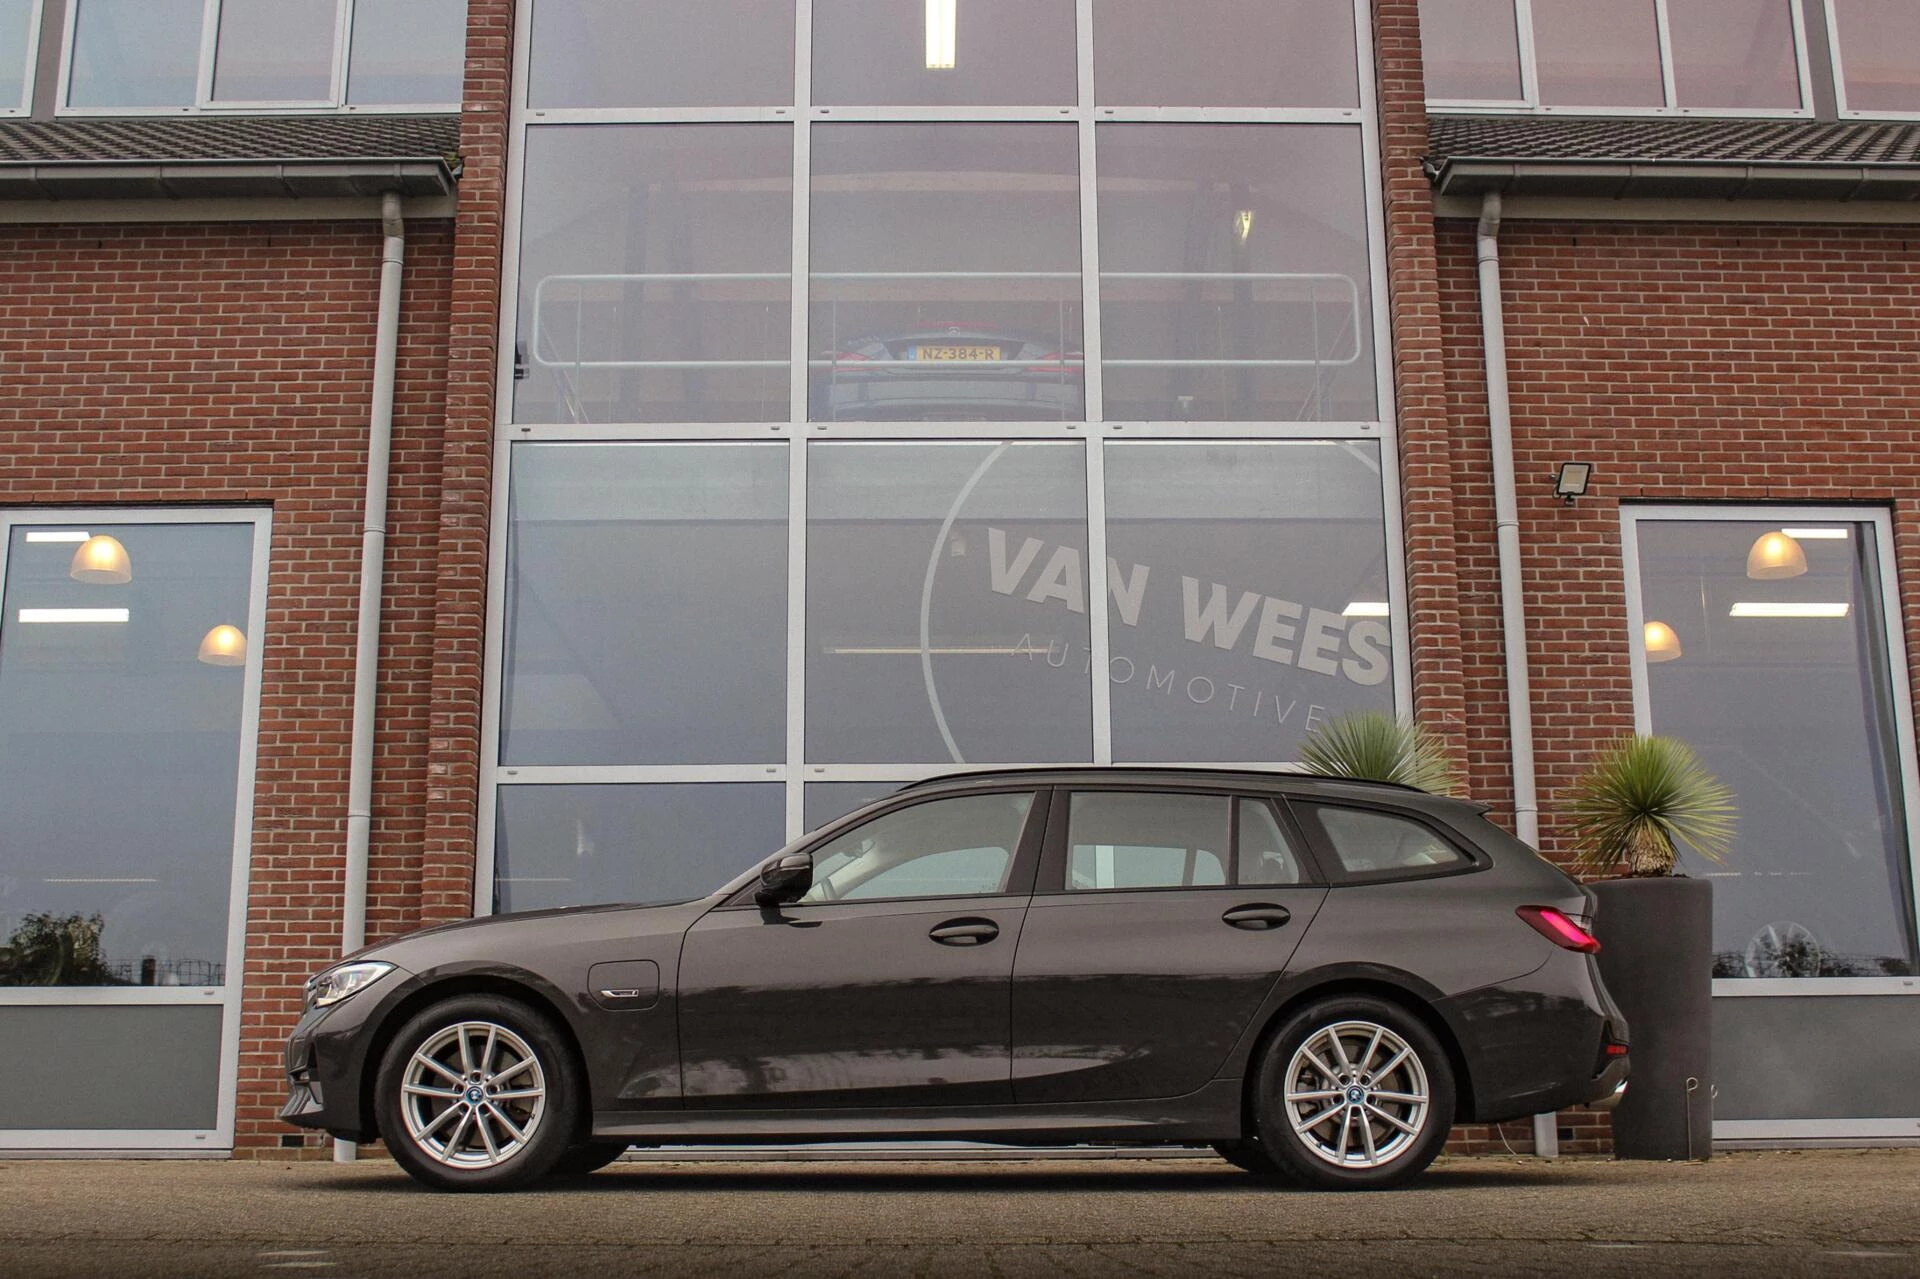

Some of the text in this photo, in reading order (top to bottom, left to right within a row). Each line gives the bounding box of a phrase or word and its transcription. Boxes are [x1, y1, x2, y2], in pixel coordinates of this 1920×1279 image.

[922, 347, 994, 360] NZ-384-R
[988, 527, 1390, 686] VAN WEES
